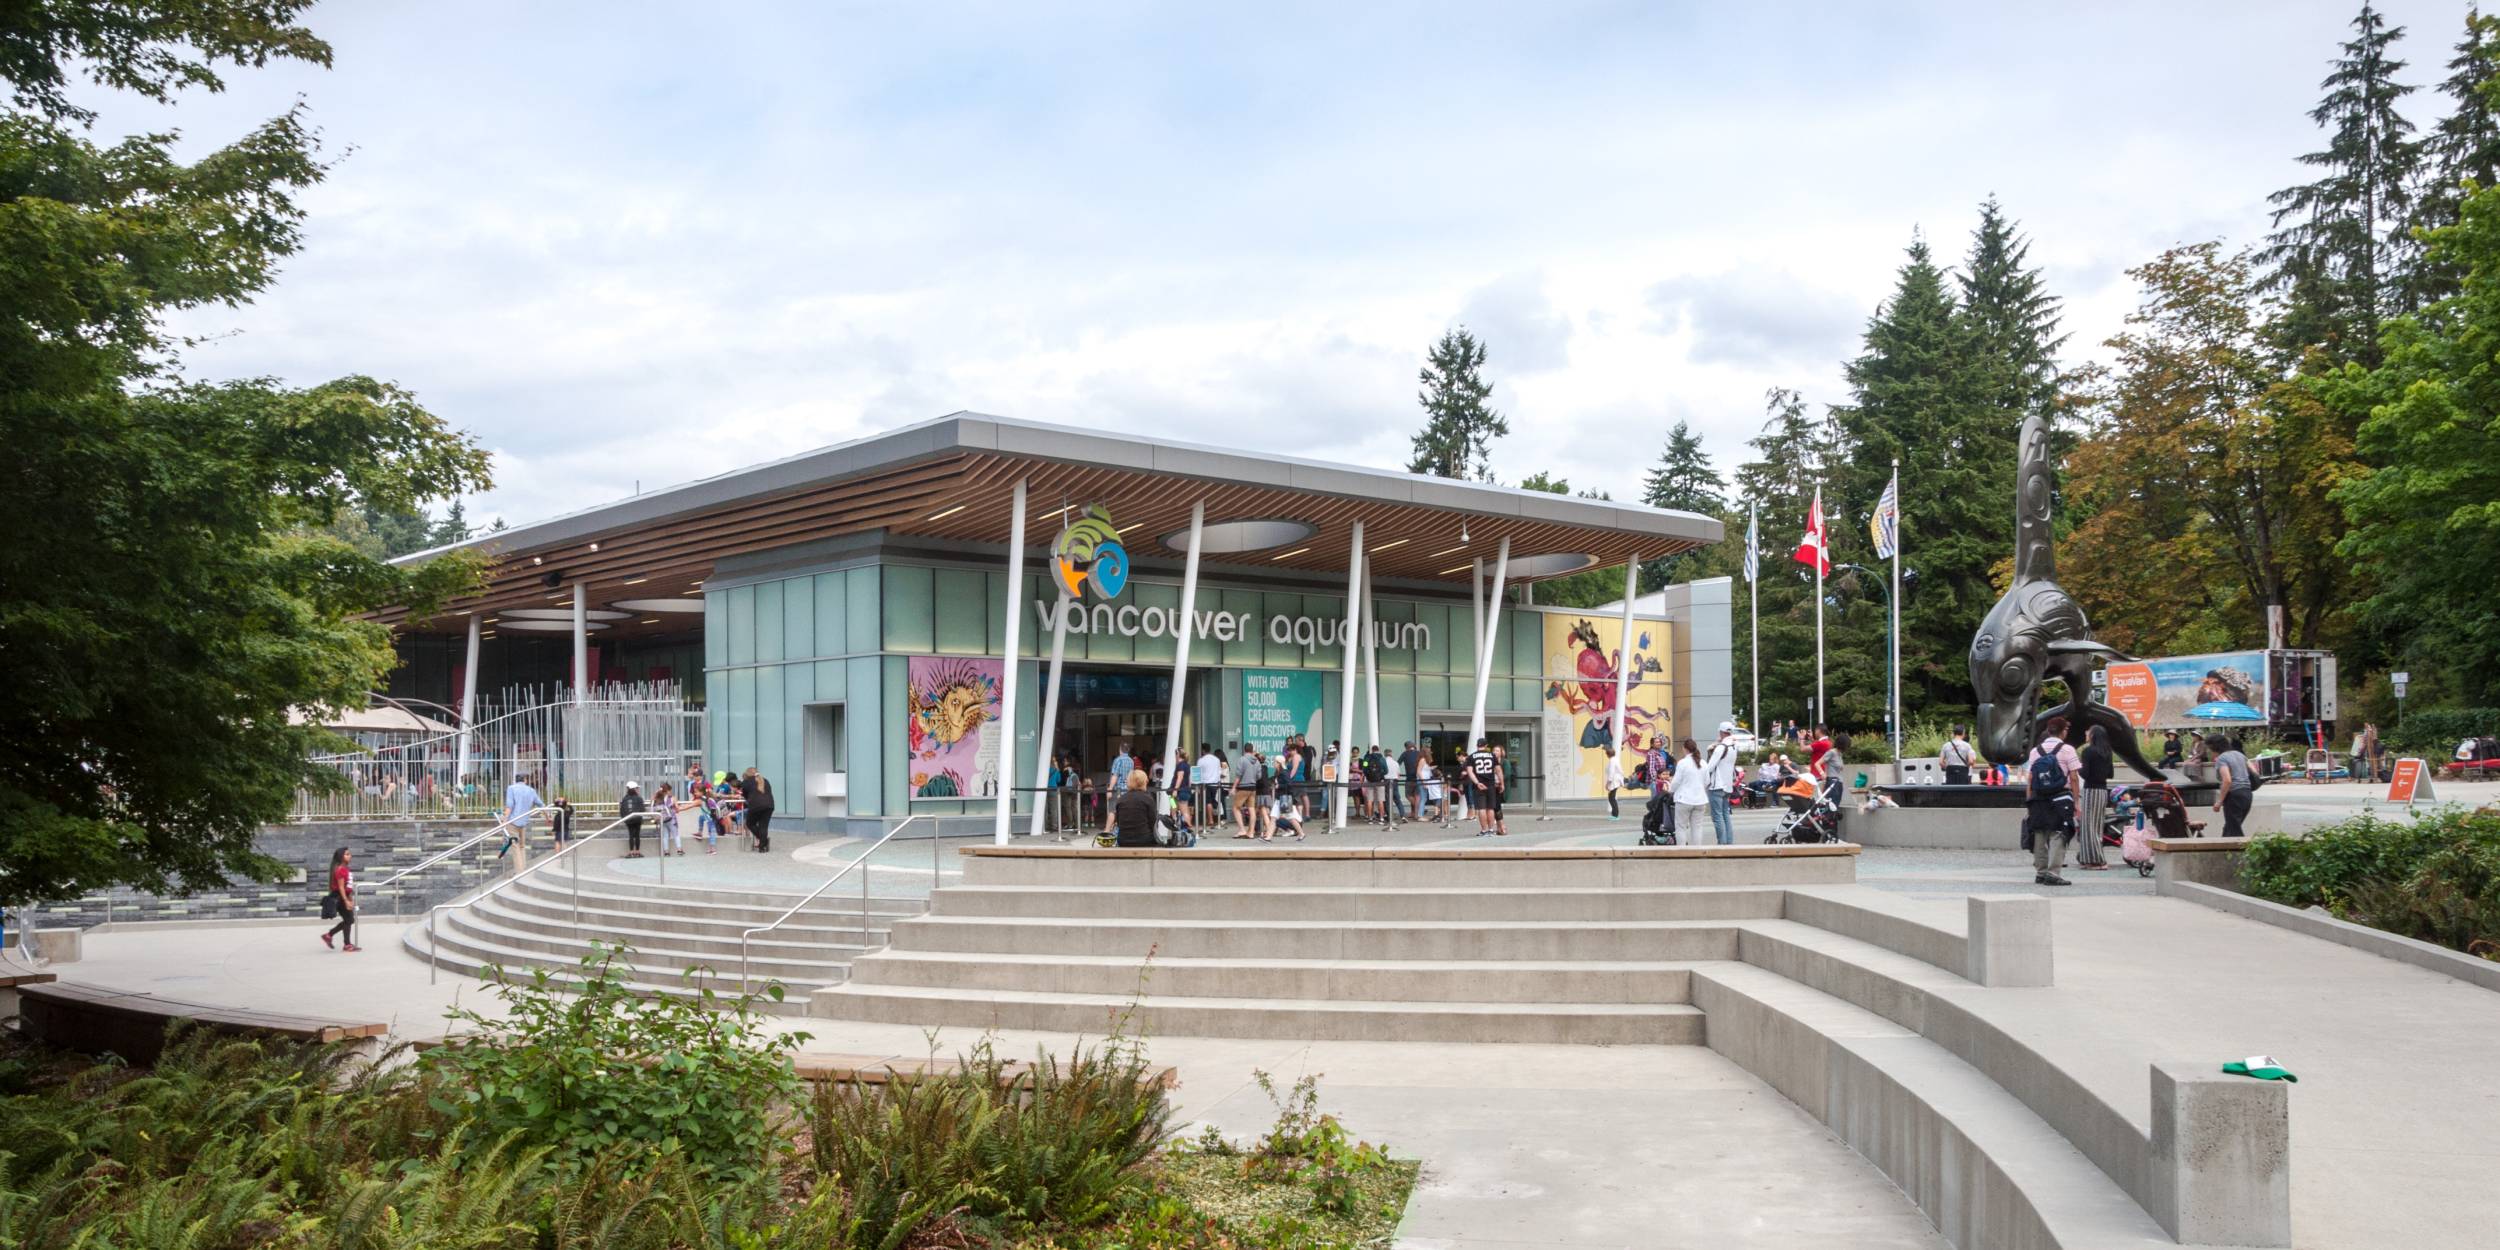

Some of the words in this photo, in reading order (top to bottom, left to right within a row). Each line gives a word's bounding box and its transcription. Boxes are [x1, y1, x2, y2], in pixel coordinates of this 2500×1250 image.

[1035, 600, 1251, 642] vancouver
[1248, 675, 1267, 689] WITH
[1270, 676, 1289, 689] OVER
[1248, 691, 1277, 707] 50,000
[1248, 709, 1291, 721] CREATURES
[1248, 724, 1258, 737] TO
[1260, 724, 1296, 737] DISCOVER
[1475, 759, 1493, 774] 22
